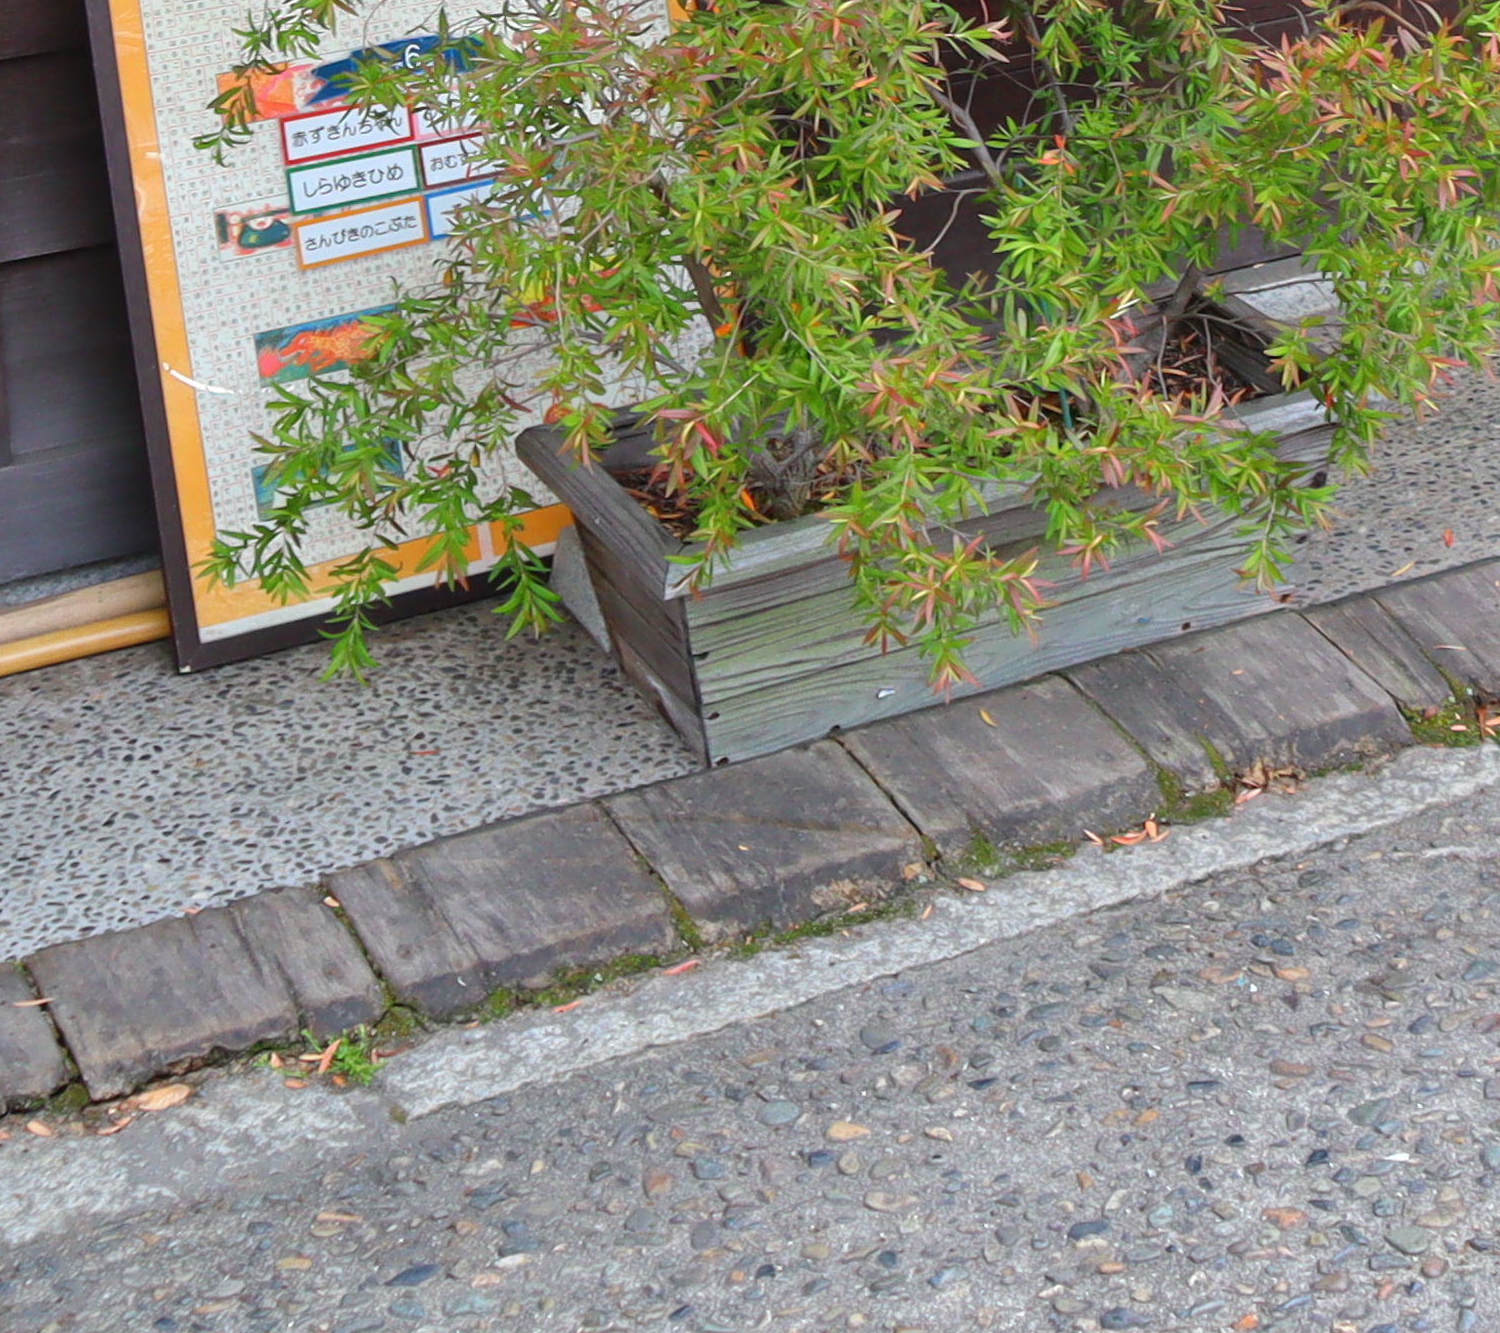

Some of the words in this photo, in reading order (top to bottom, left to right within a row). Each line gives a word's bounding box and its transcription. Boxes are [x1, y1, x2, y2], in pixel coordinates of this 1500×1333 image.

[302, 163, 404, 199] しらゆきひめ
[304, 214, 418, 252] さんびきのこぶた
